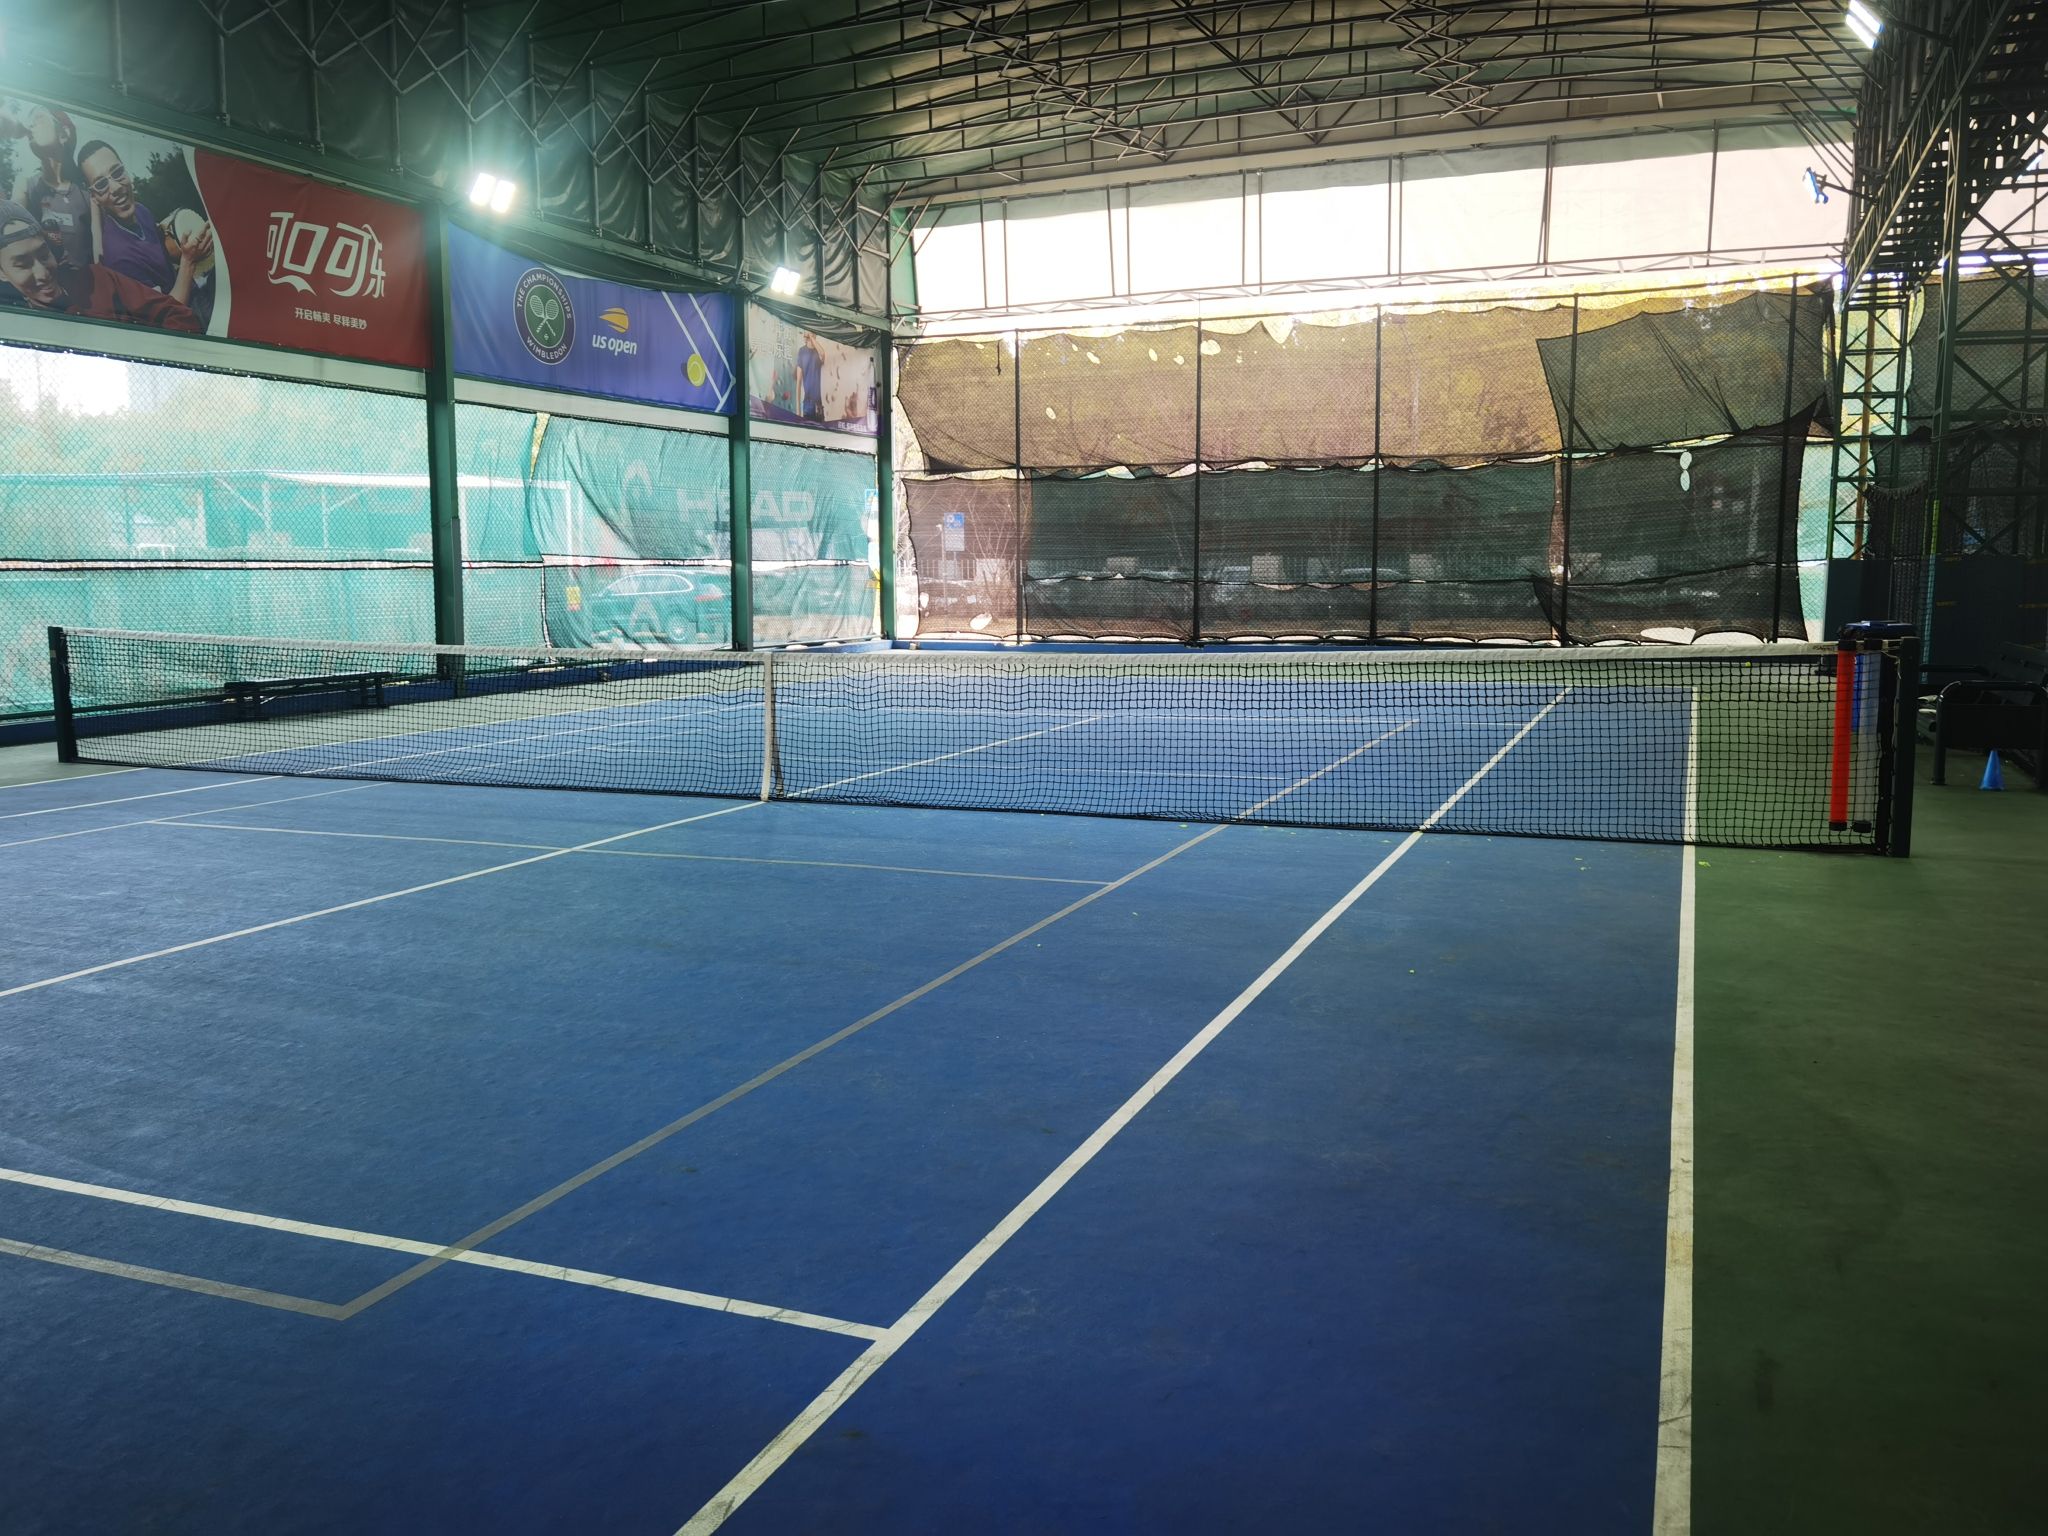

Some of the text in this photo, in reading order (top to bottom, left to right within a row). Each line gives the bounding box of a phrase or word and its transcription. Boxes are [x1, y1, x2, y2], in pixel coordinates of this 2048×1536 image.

[267, 212, 386, 298] 可口可乐
[517, 273, 572, 319] THE CHAMPIONSHIPS
[295, 307, 331, 324] 开启畅爽
[526, 336, 568, 360] WIMBLEDON
[592, 334, 637, 356] us open
